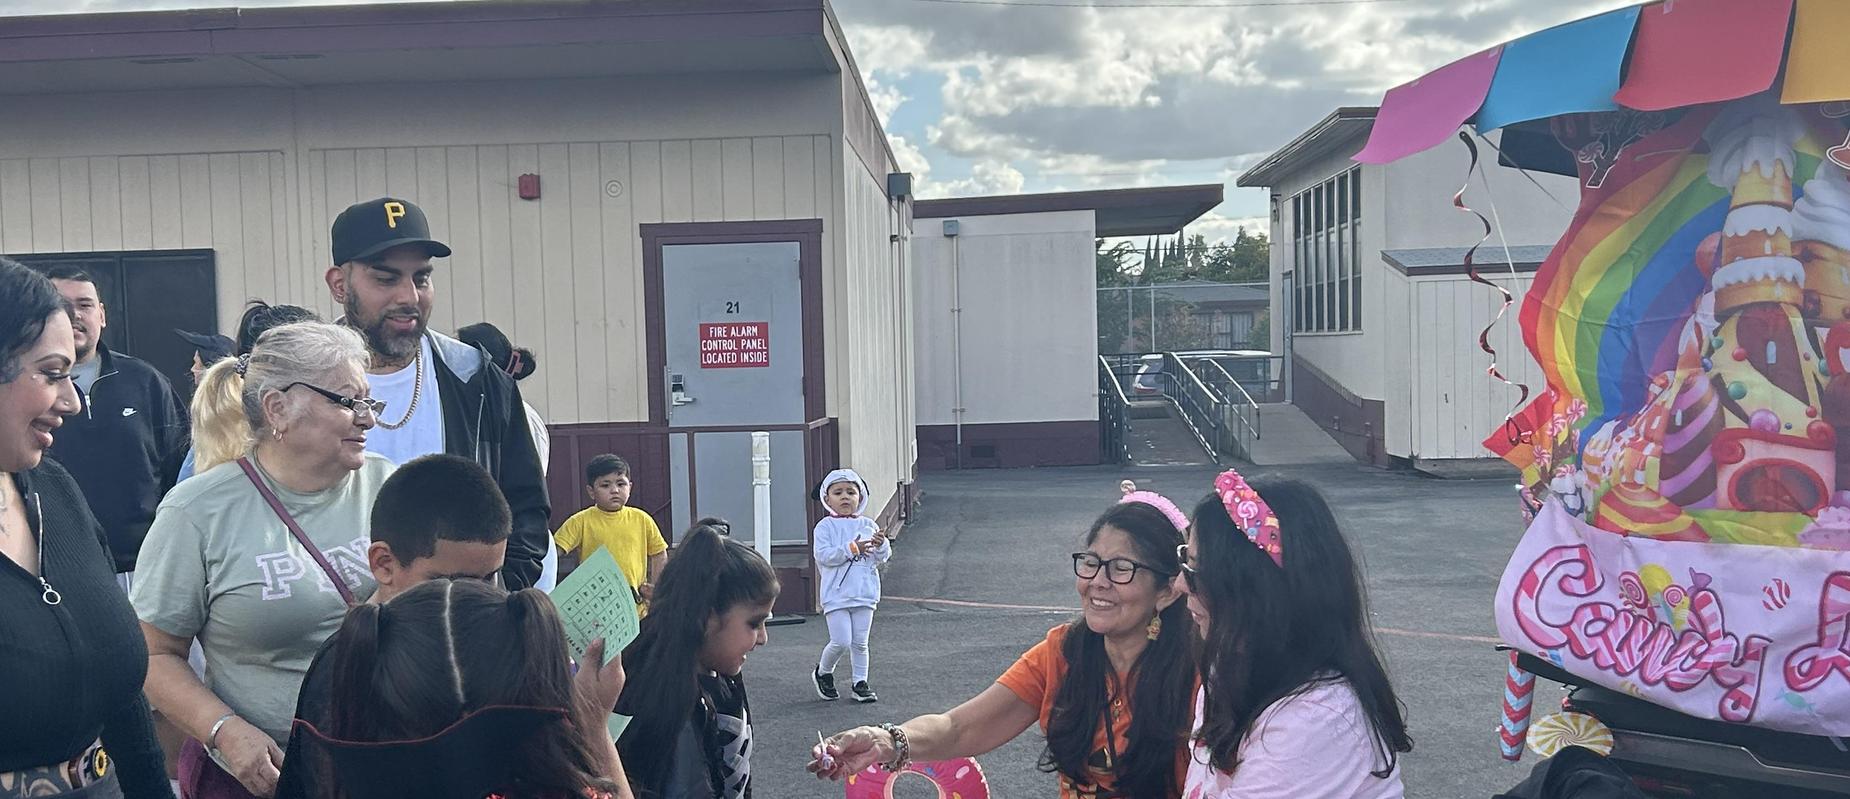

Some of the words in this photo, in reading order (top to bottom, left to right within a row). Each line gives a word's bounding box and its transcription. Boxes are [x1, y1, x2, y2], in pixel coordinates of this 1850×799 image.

[384, 202, 406, 228] P
[726, 301, 740, 314] 21
[709, 326, 728, 338] FIRE
[730, 325, 758, 337] ALARM
[701, 339, 739, 351] CONTROL
[741, 338, 767, 350] PANEL
[702, 352, 737, 364] LOCATED
[740, 351, 767, 363] INSIDE
[1513, 543, 1773, 722] Candy
